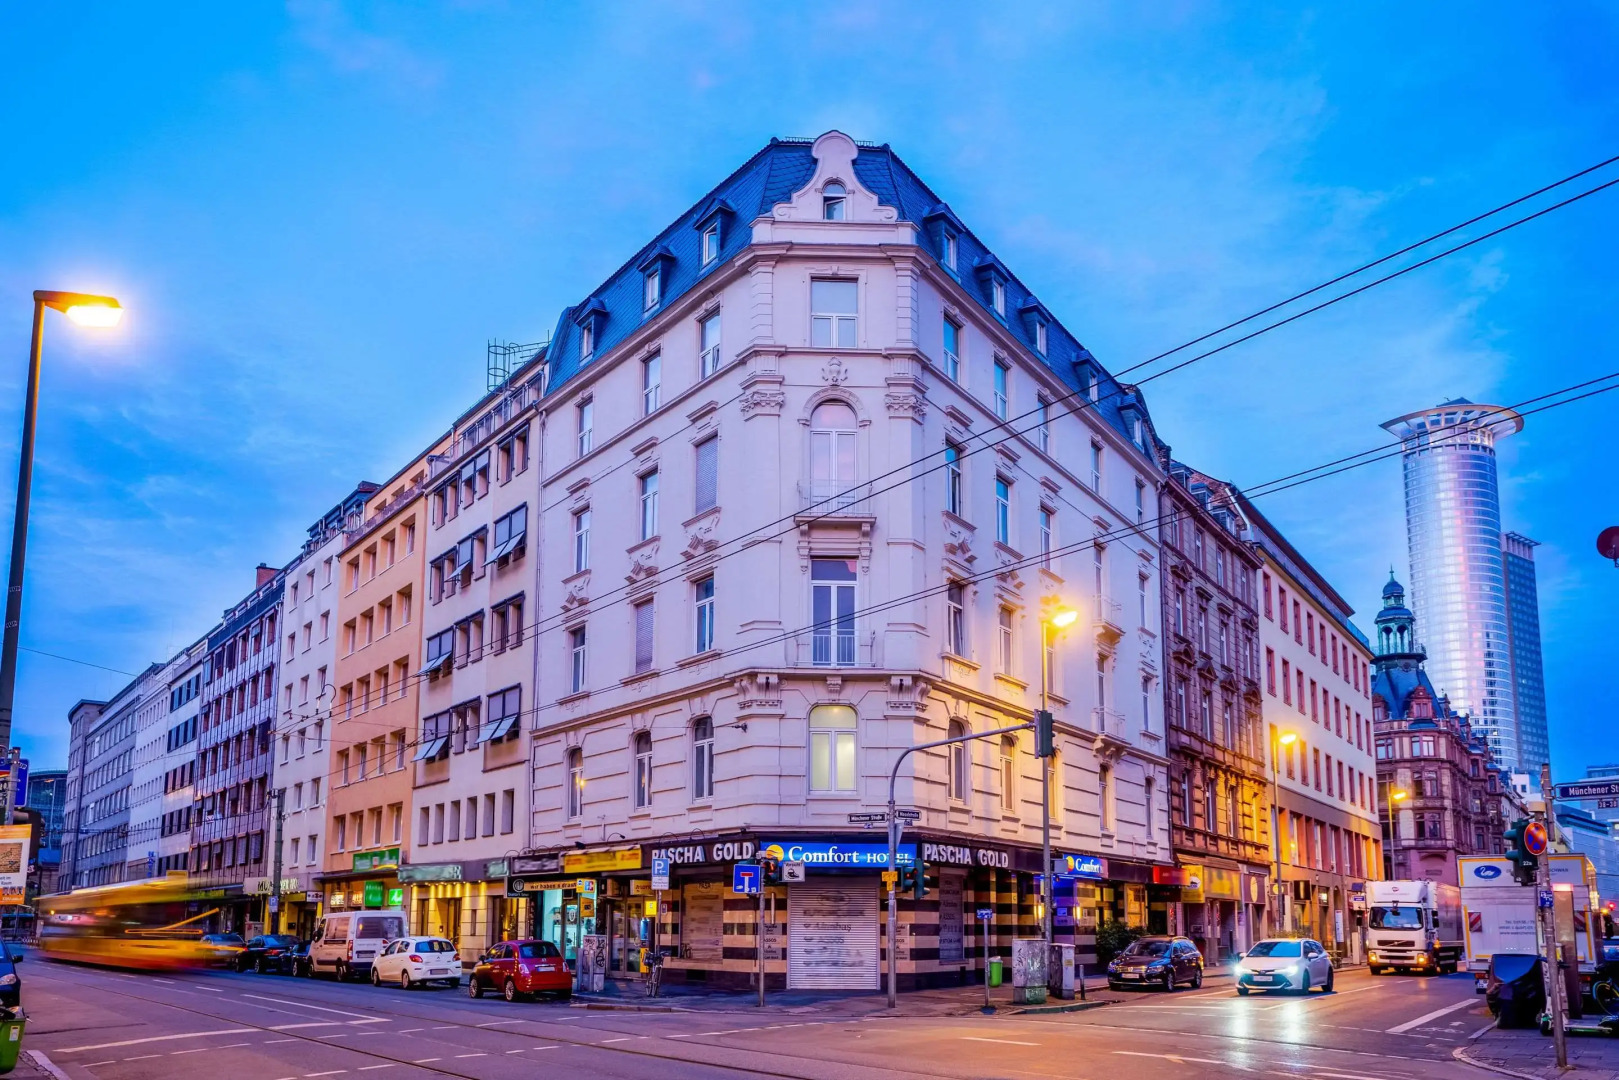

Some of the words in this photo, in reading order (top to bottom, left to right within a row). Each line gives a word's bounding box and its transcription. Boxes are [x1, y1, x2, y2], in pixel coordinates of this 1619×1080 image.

[1568, 785, 1609, 796] Münchener
[652, 846, 705, 864] PASCHA
[713, 842, 755, 861] GOLD
[788, 846, 860, 863] Comfort
[866, 853, 913, 864] HOEL
[923, 844, 972, 865] PASCHA
[978, 849, 1009, 868] GOLD
[1075, 858, 1103, 874] Comfort
